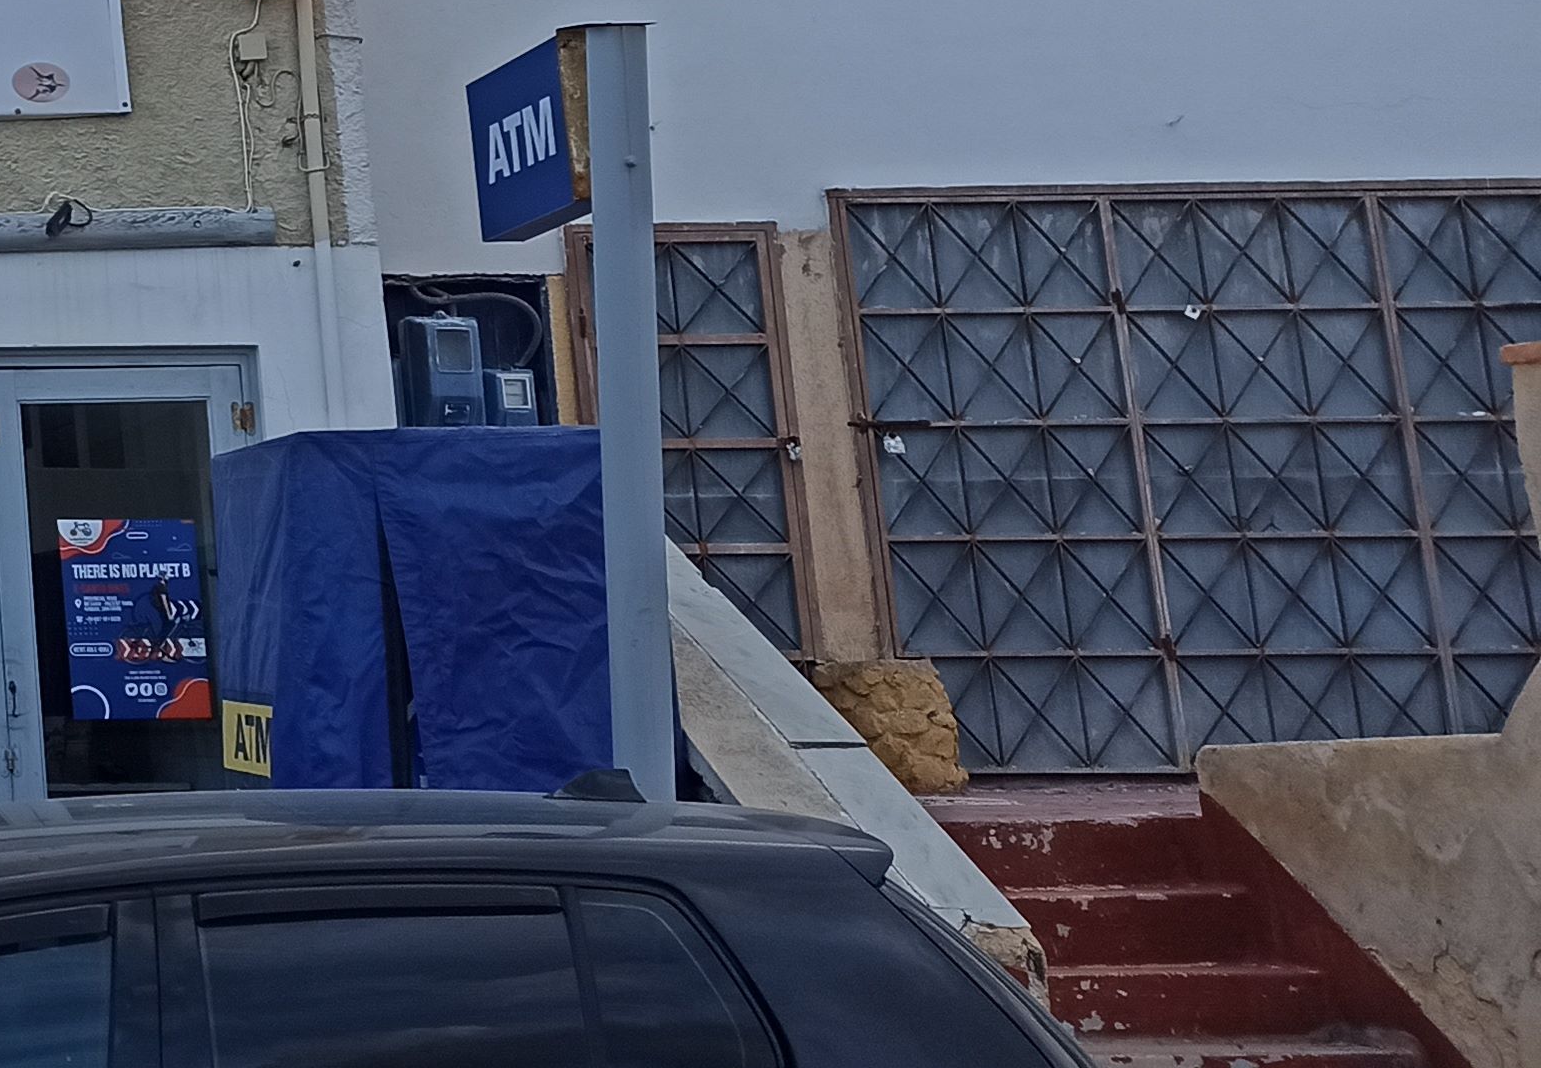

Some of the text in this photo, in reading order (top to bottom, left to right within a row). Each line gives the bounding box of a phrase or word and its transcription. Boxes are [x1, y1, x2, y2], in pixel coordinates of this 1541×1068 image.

[488, 96, 557, 185] ATM
[72, 564, 108, 579] THERE
[109, 564, 120, 578] IS
[122, 564, 138, 578] NO
[182, 563, 191, 577] B
